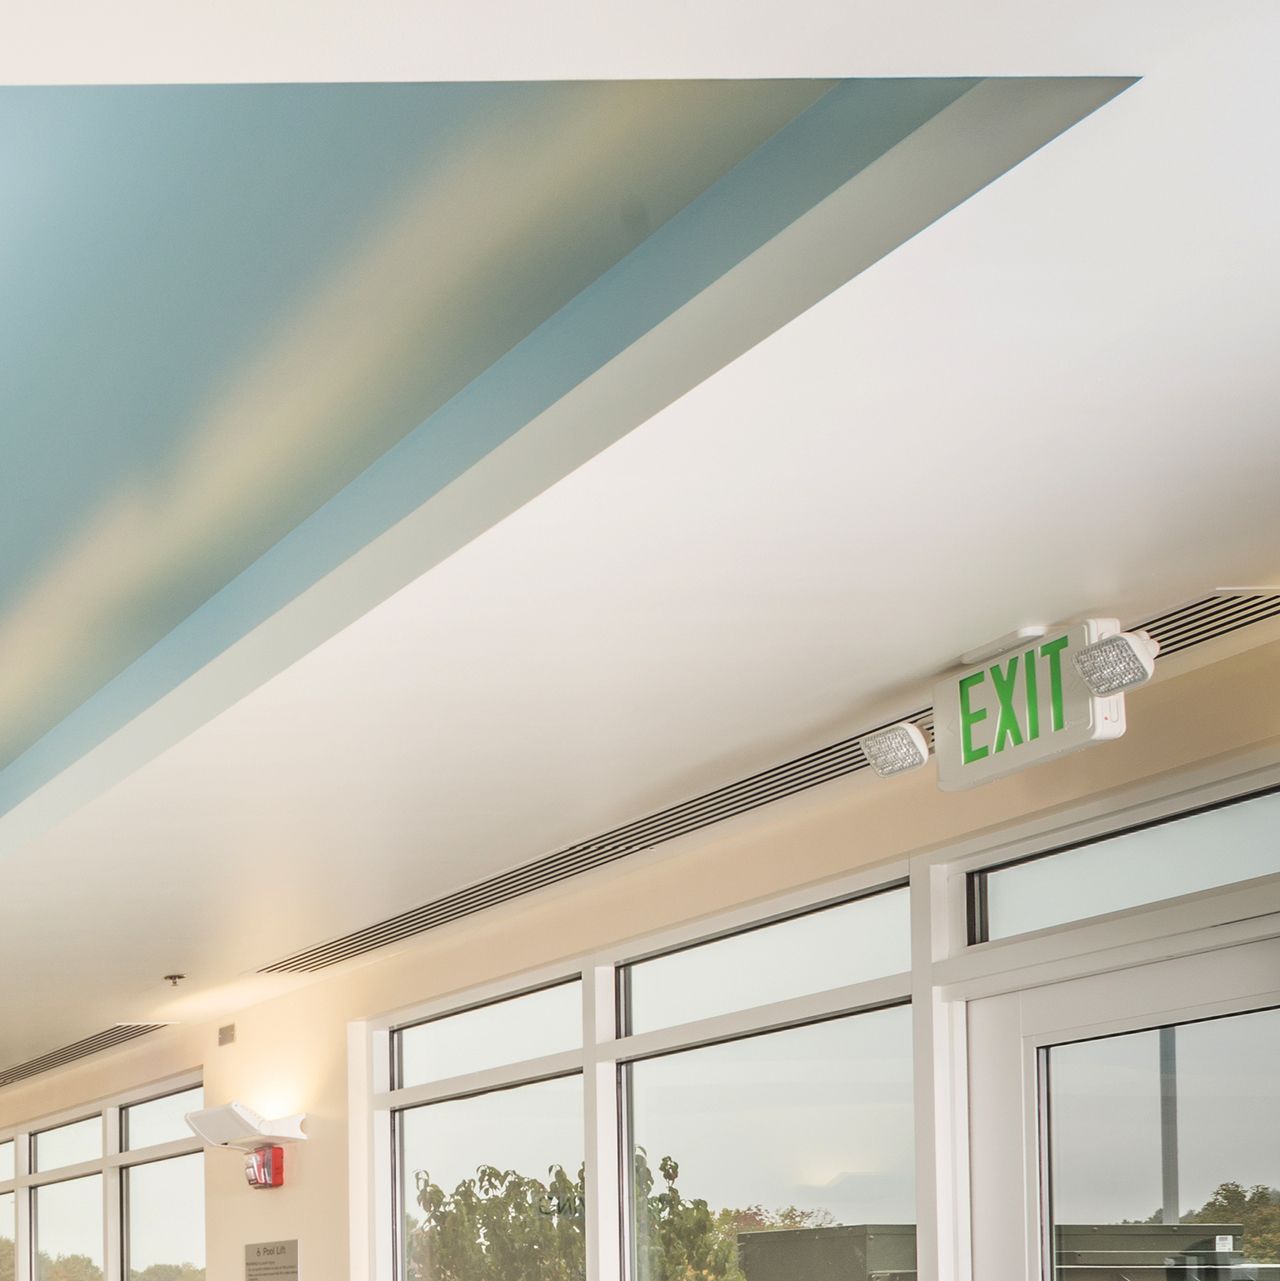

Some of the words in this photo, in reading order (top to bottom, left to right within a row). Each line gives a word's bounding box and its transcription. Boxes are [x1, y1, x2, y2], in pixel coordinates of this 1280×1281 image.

[958, 634, 1069, 766] EXIT
[262, 1246, 275, 1256] Pool
[276, 1245, 287, 1256] Lift
